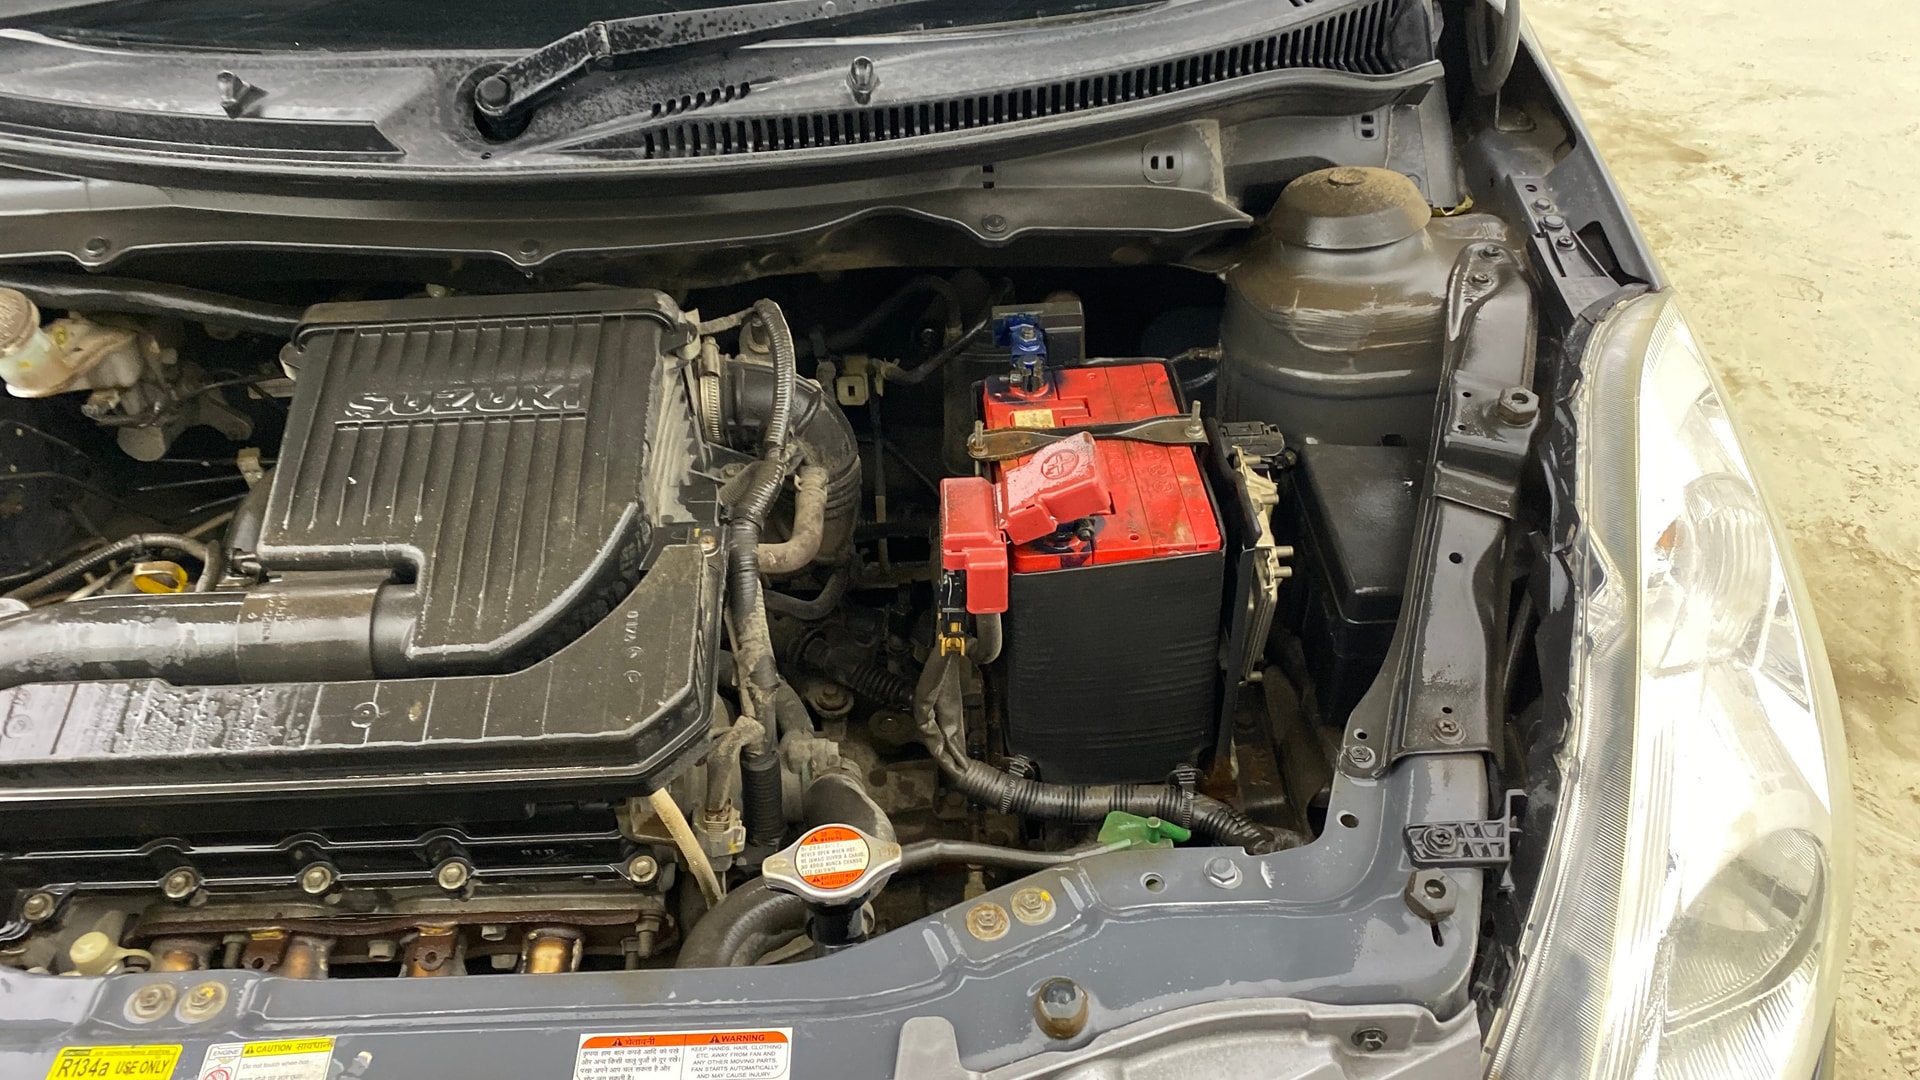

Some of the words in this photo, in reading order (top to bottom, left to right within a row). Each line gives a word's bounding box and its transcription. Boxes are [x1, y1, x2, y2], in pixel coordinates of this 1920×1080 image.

[344, 384, 580, 418] SUZUKI
[721, 1034, 766, 1043] WARNING
[256, 1044, 293, 1053] CAUTION
[56, 1058, 110, 1078] R134a
[115, 1060, 139, 1075] USE
[140, 1060, 170, 1074] ONLY
